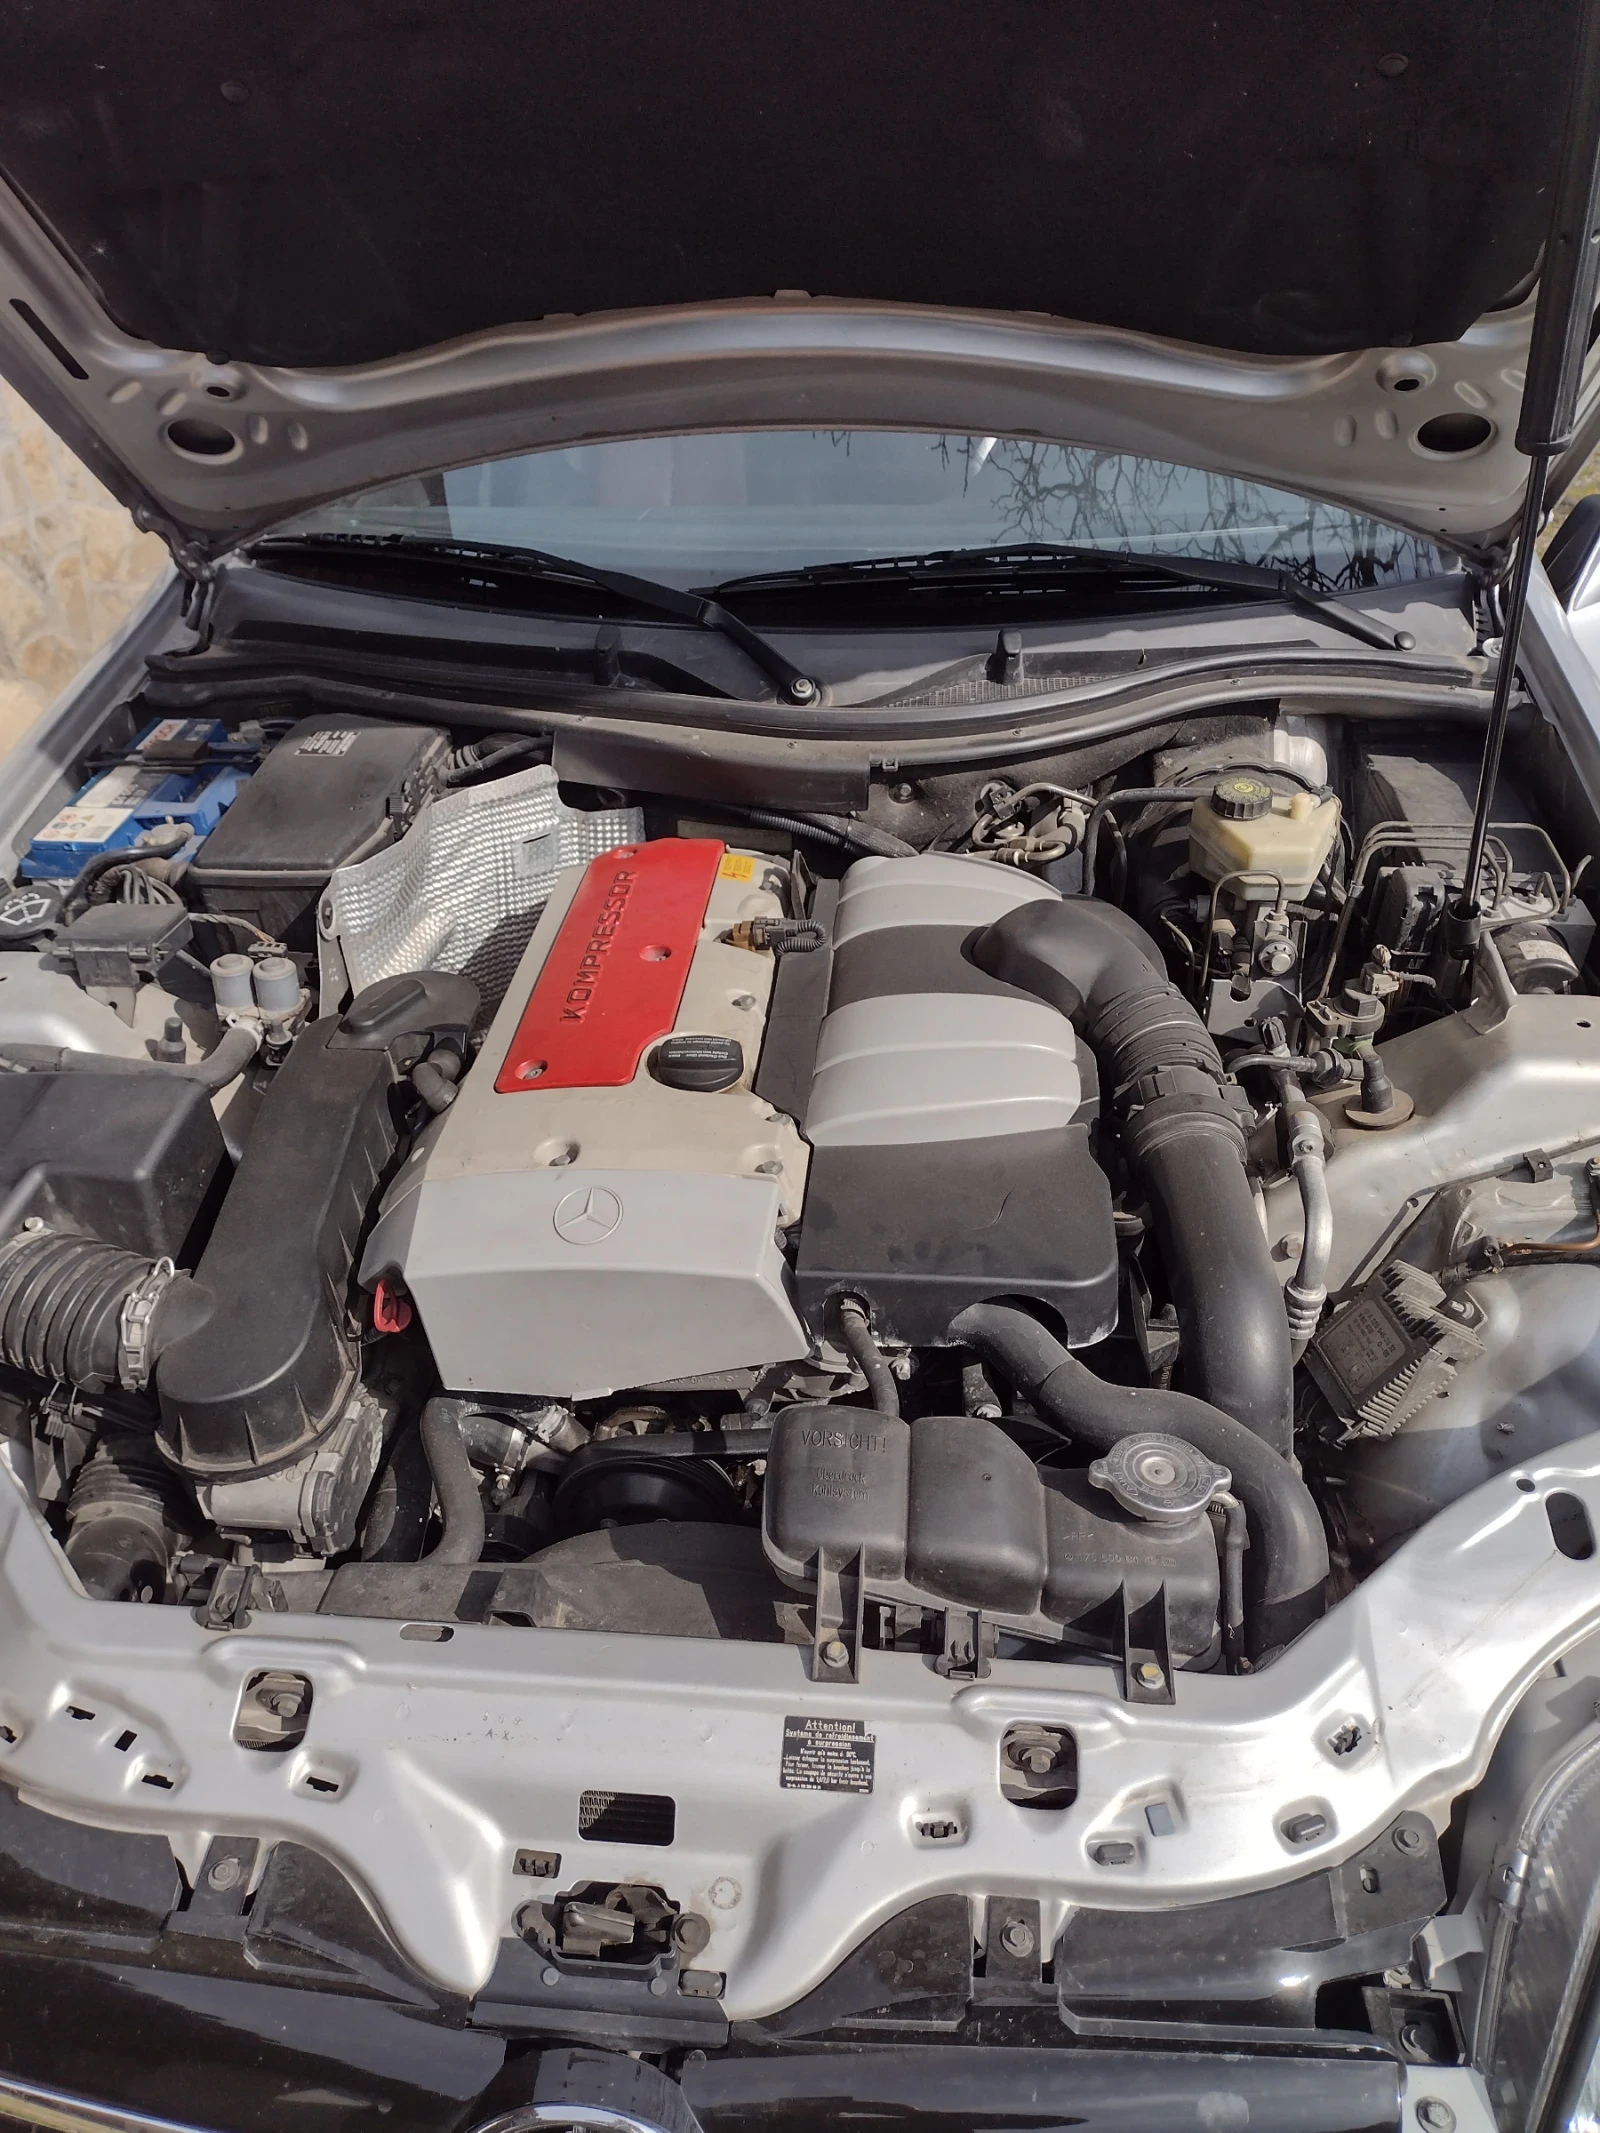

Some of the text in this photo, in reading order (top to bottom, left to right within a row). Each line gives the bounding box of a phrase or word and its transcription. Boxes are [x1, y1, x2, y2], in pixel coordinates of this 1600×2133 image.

[560, 870, 637, 1024] KOMPRESSOR
[802, 1430, 886, 1453] VORSICHT!
[805, 1719, 856, 1732] Attention!
